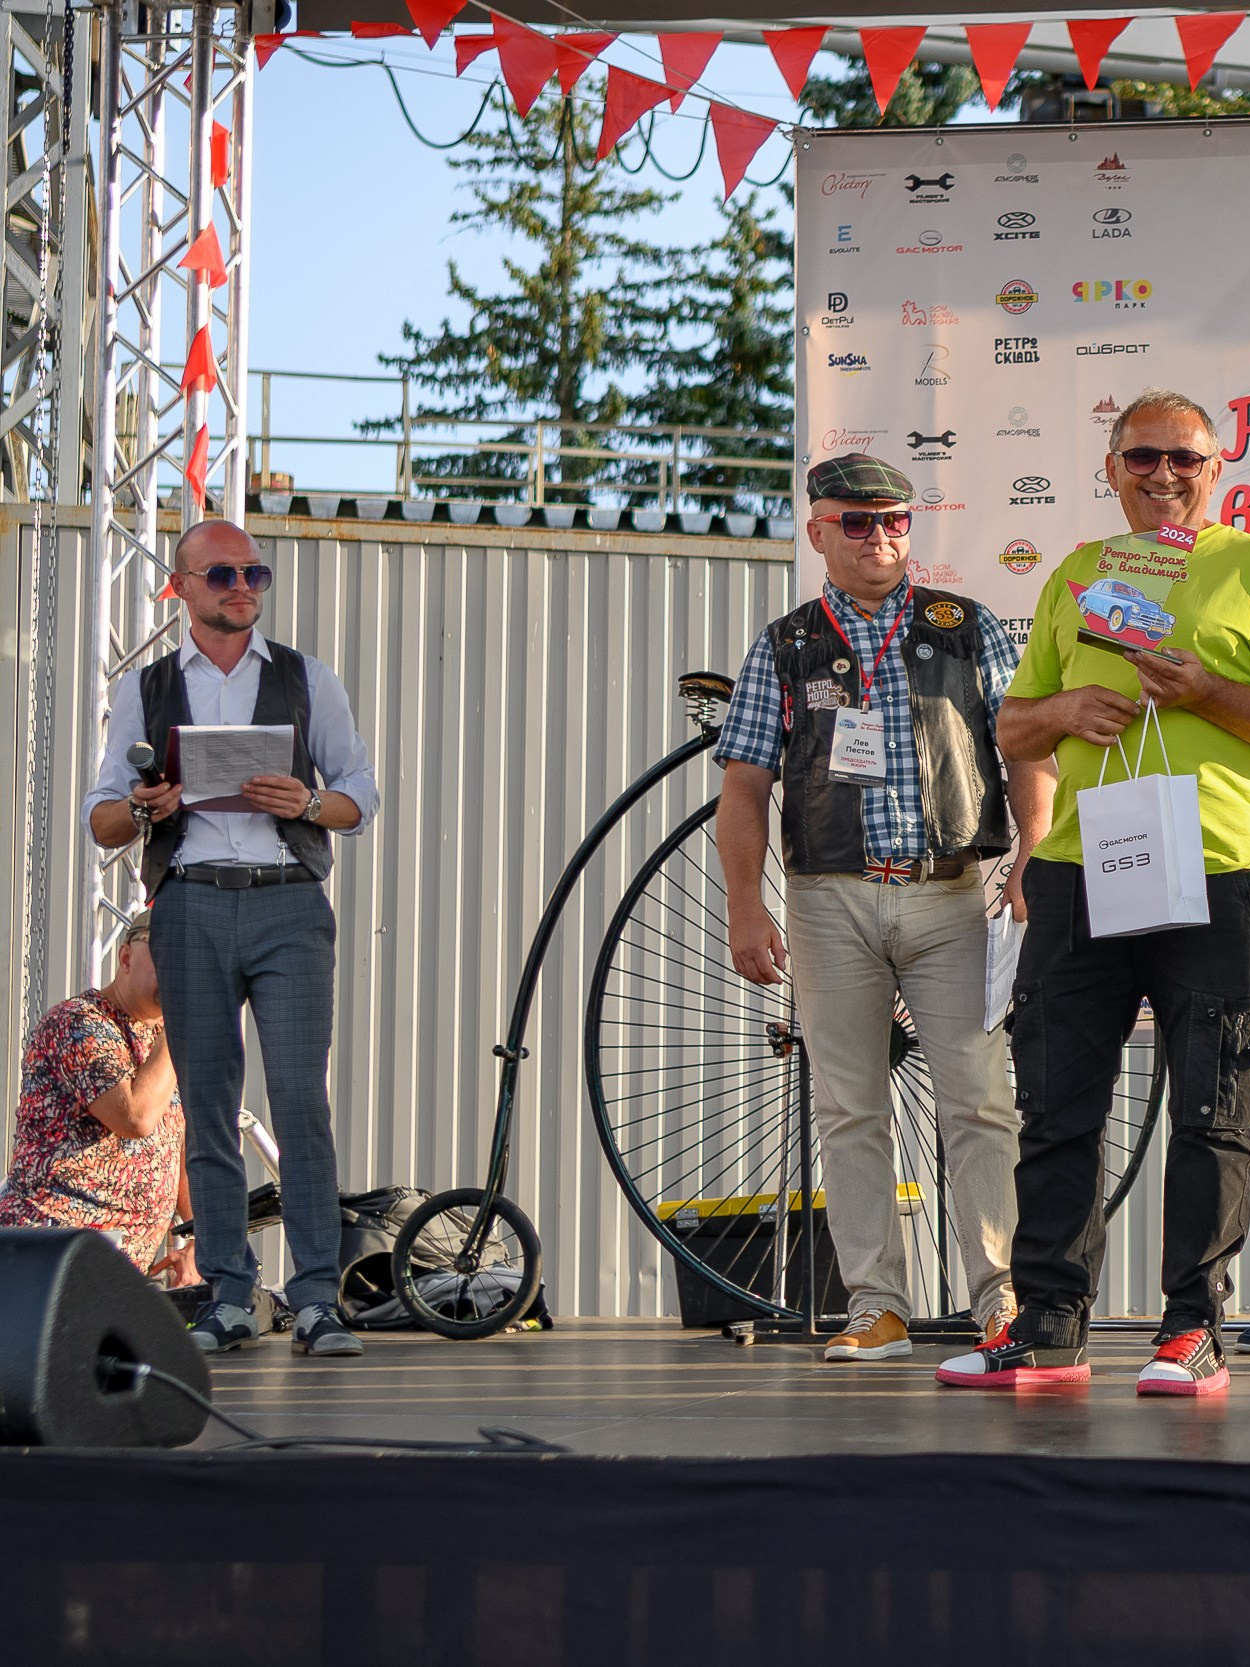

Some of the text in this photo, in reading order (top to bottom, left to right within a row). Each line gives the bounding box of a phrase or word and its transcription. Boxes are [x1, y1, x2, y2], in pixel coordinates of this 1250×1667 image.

[822, 173, 873, 199] Victory
[993, 231, 1040, 241] XCITE
[1092, 228, 1132, 239] LADA
[829, 246, 860, 254] EVOLUTE
[1072, 279, 1153, 302] ЯРКО
[995, 337, 1038, 350] РЕТРО
[915, 378, 948, 386] MODELS
[1009, 496, 1055, 505] XCITE
[1160, 526, 1194, 545] 2024
[1102, 546, 1187, 567] Ретро-Гараж
[1098, 560, 1188, 580] во Владимире
[1000, 618, 1034, 630] РЕТР
[806, 680, 833, 693] РЕТРО
[807, 690, 829, 702] МОТО
[853, 739, 869, 747] Лев
[845, 746, 875, 756] Пестов
[1102, 852, 1151, 874] GS3
